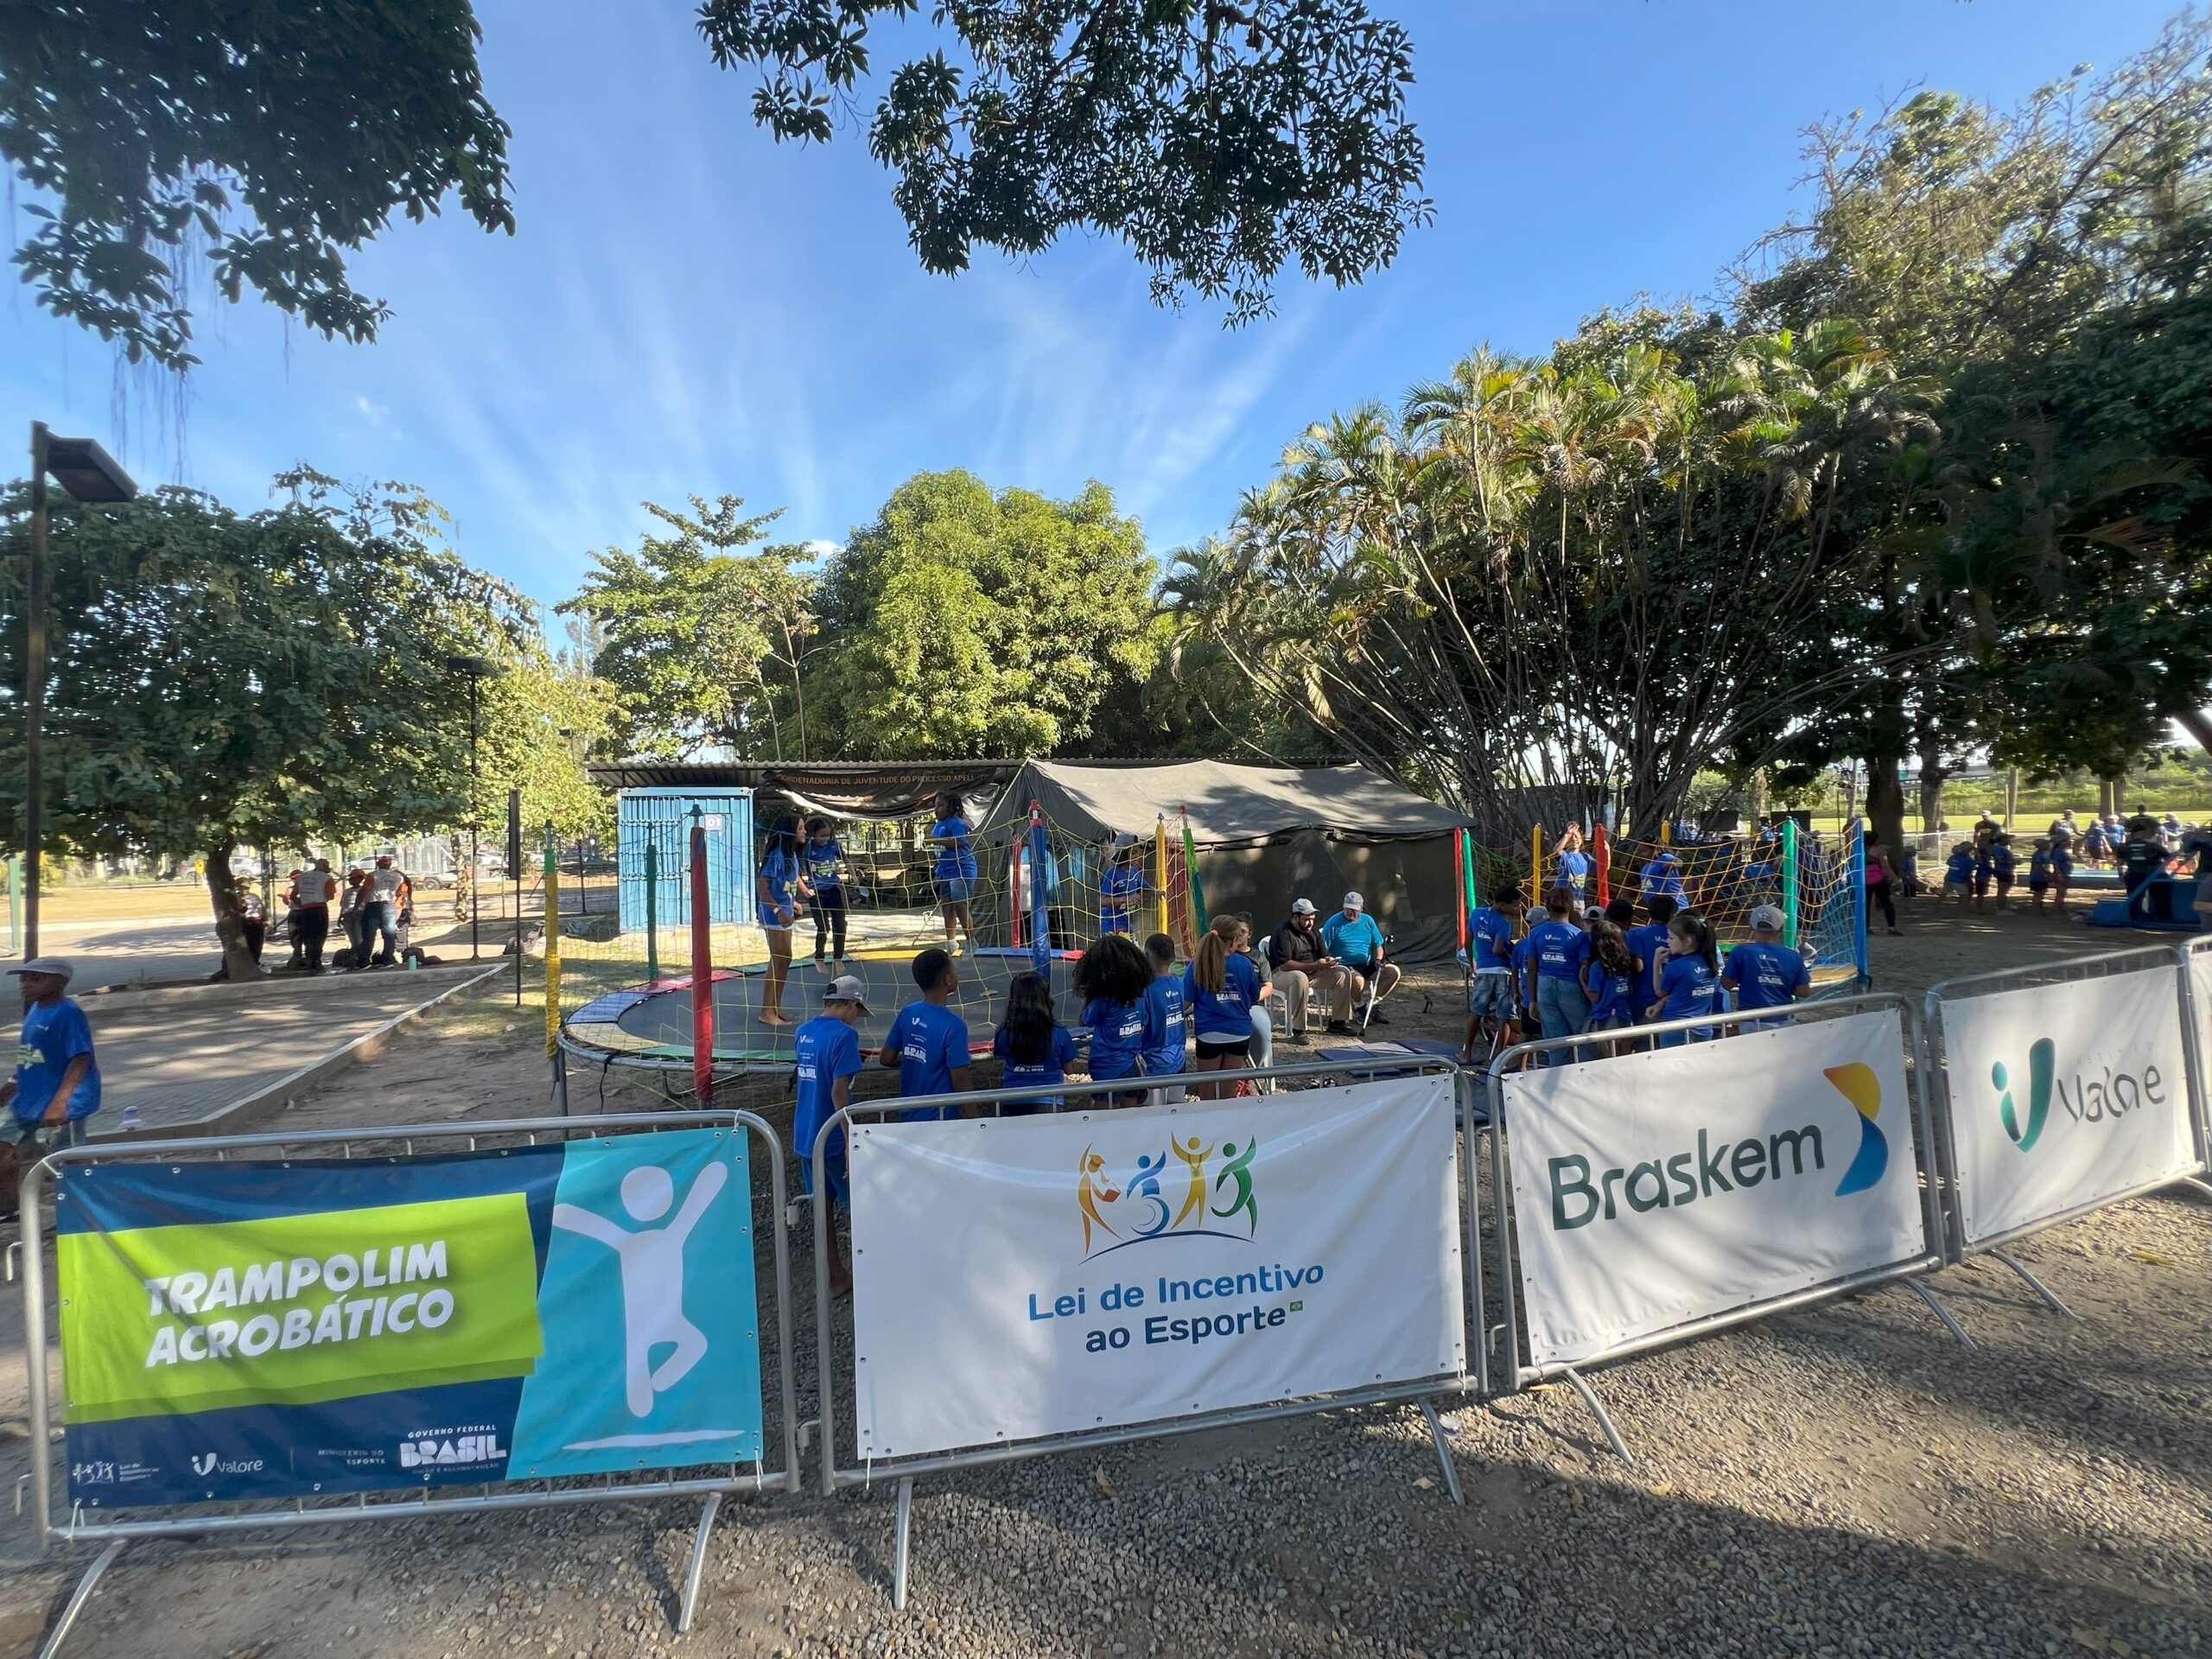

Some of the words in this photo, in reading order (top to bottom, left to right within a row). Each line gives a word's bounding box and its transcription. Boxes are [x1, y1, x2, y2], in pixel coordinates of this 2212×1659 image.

[1548, 1124, 1825, 1230] Braskem
[144, 1240, 448, 1316] TRAMPOLIM
[1028, 1287, 1086, 1321] Lei
[1100, 1283, 1144, 1311] de
[1159, 1263, 1324, 1304] Incentivo
[145, 1289, 454, 1368] ACROBÁTICO
[1085, 1325, 1130, 1352] ao
[1145, 1305, 1286, 1344] Esporte
[400, 1434, 507, 1467] BRASIL
[408, 1427, 454, 1439] GOVERNO
[456, 1424, 497, 1433] FEDERAL
[216, 1459, 264, 1474] Valore
